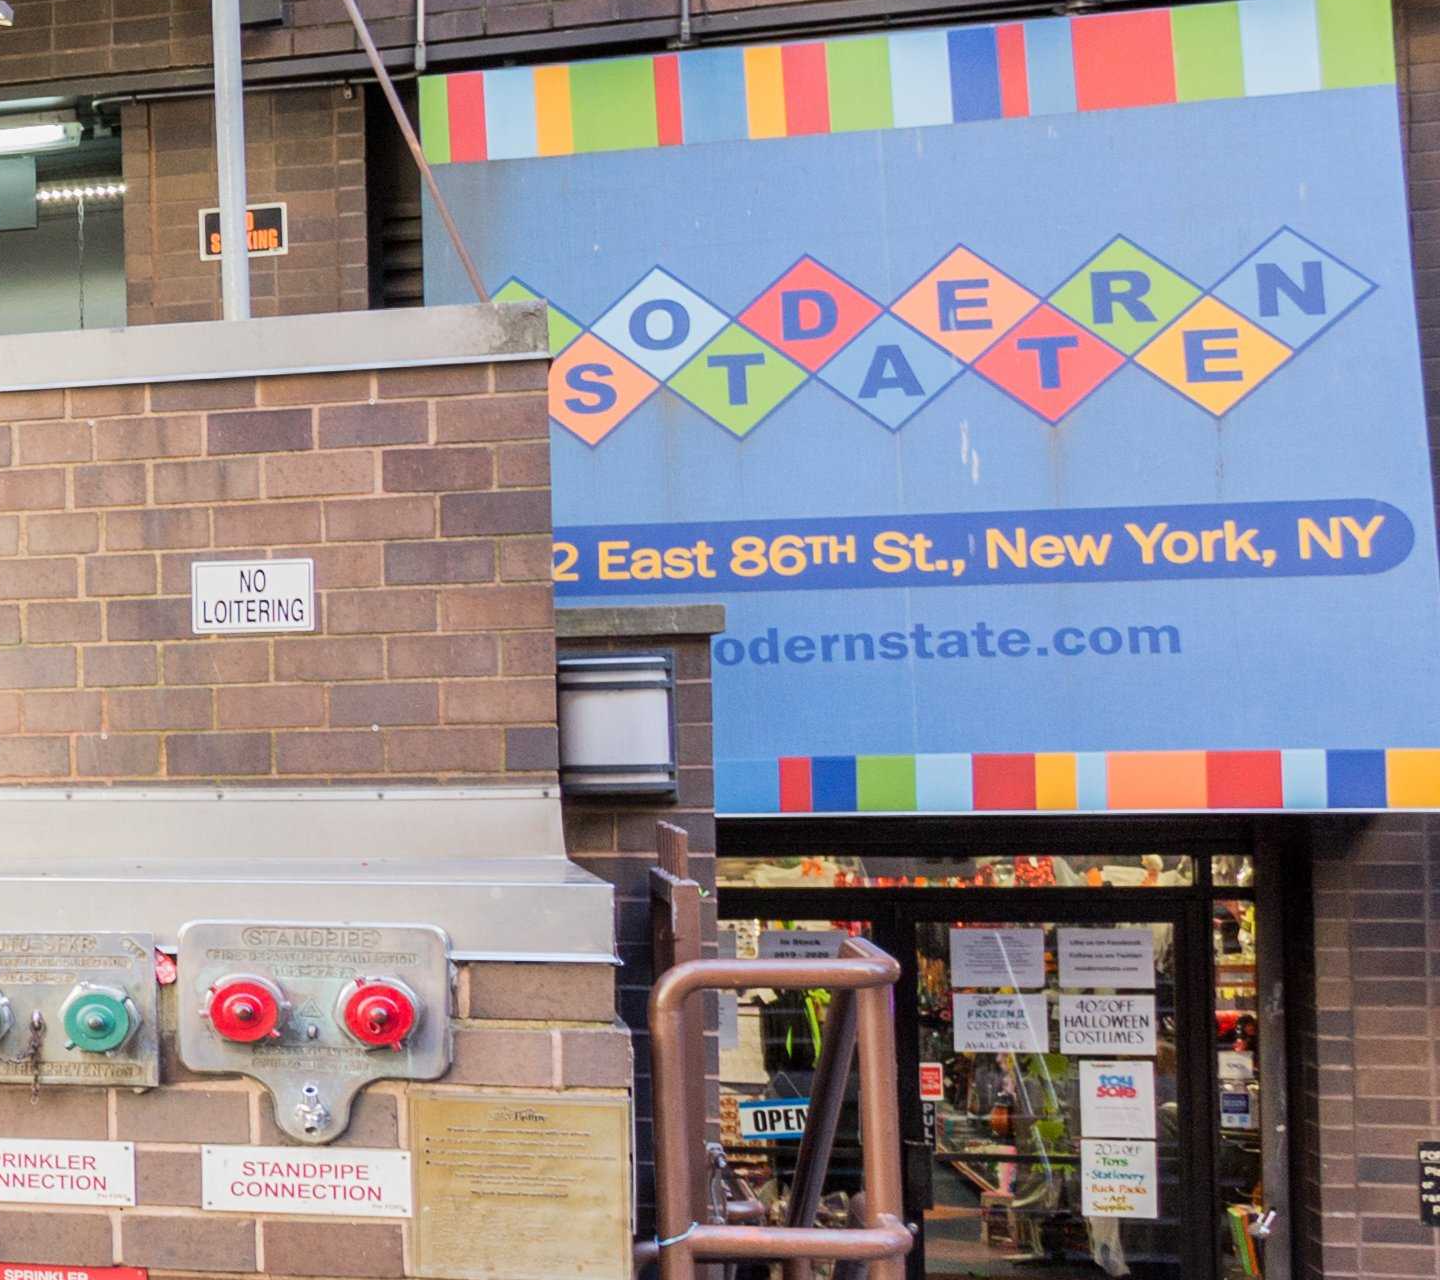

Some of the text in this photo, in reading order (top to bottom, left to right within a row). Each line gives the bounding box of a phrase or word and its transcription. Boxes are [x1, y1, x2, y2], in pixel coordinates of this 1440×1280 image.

[210, 228, 278, 254] SKING
[627, 258, 1326, 352] ODERN
[563, 326, 1244, 415] STATE
[597, 540, 717, 580] East
[870, 529, 966, 579] St.,
[984, 525, 1112, 571] New
[1124, 520, 1277, 568] York,
[1297, 514, 1385, 561] NY
[240, 569, 266, 593] NO
[203, 598, 304, 624] LOITERING
[712, 619, 1182, 666] odernstate.com
[246, 929, 374, 947] STANDPIPE
[792, 938, 821, 946] Stock
[805, 950, 830, 959] 2020
[967, 1020, 1029, 1031] COSTUMES
[1064, 1015, 1150, 1030] HALLOWEEN
[1064, 1030, 1145, 1045] COSTUMES
[242, 1160, 370, 1181] STANDPIPE
[230, 1181, 383, 1202] CONNECTION
